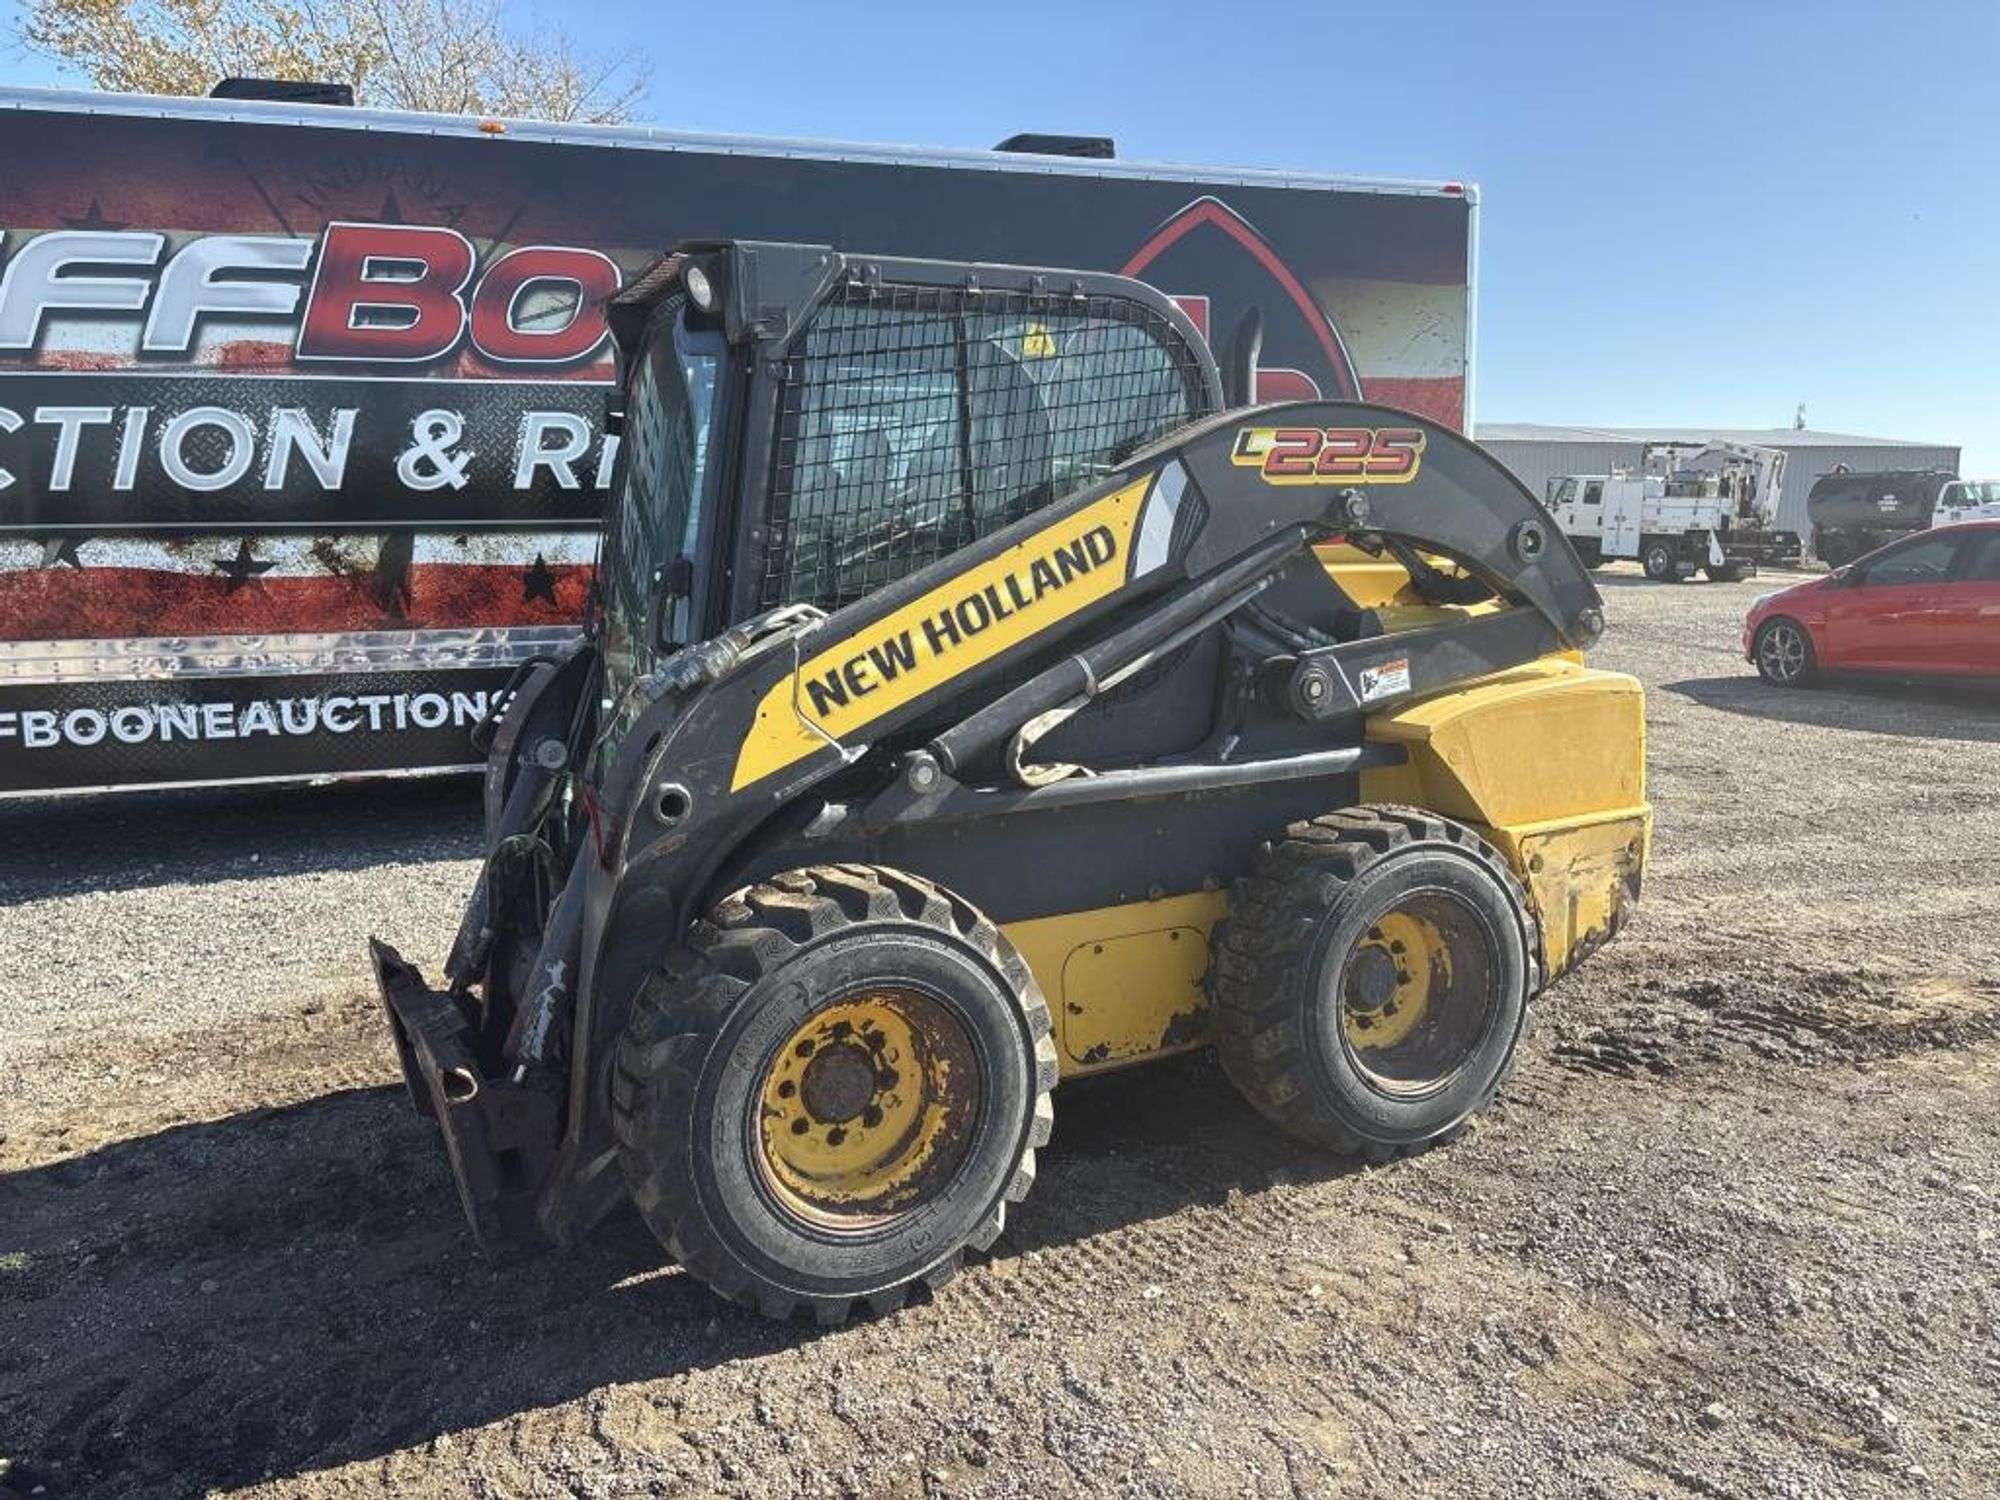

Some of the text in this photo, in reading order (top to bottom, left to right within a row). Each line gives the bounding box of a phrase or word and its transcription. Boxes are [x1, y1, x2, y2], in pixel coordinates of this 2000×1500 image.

[396, 407, 475, 491] &
[1230, 427, 1427, 485] L225
[805, 524, 1117, 718] NEW HOLLAND
